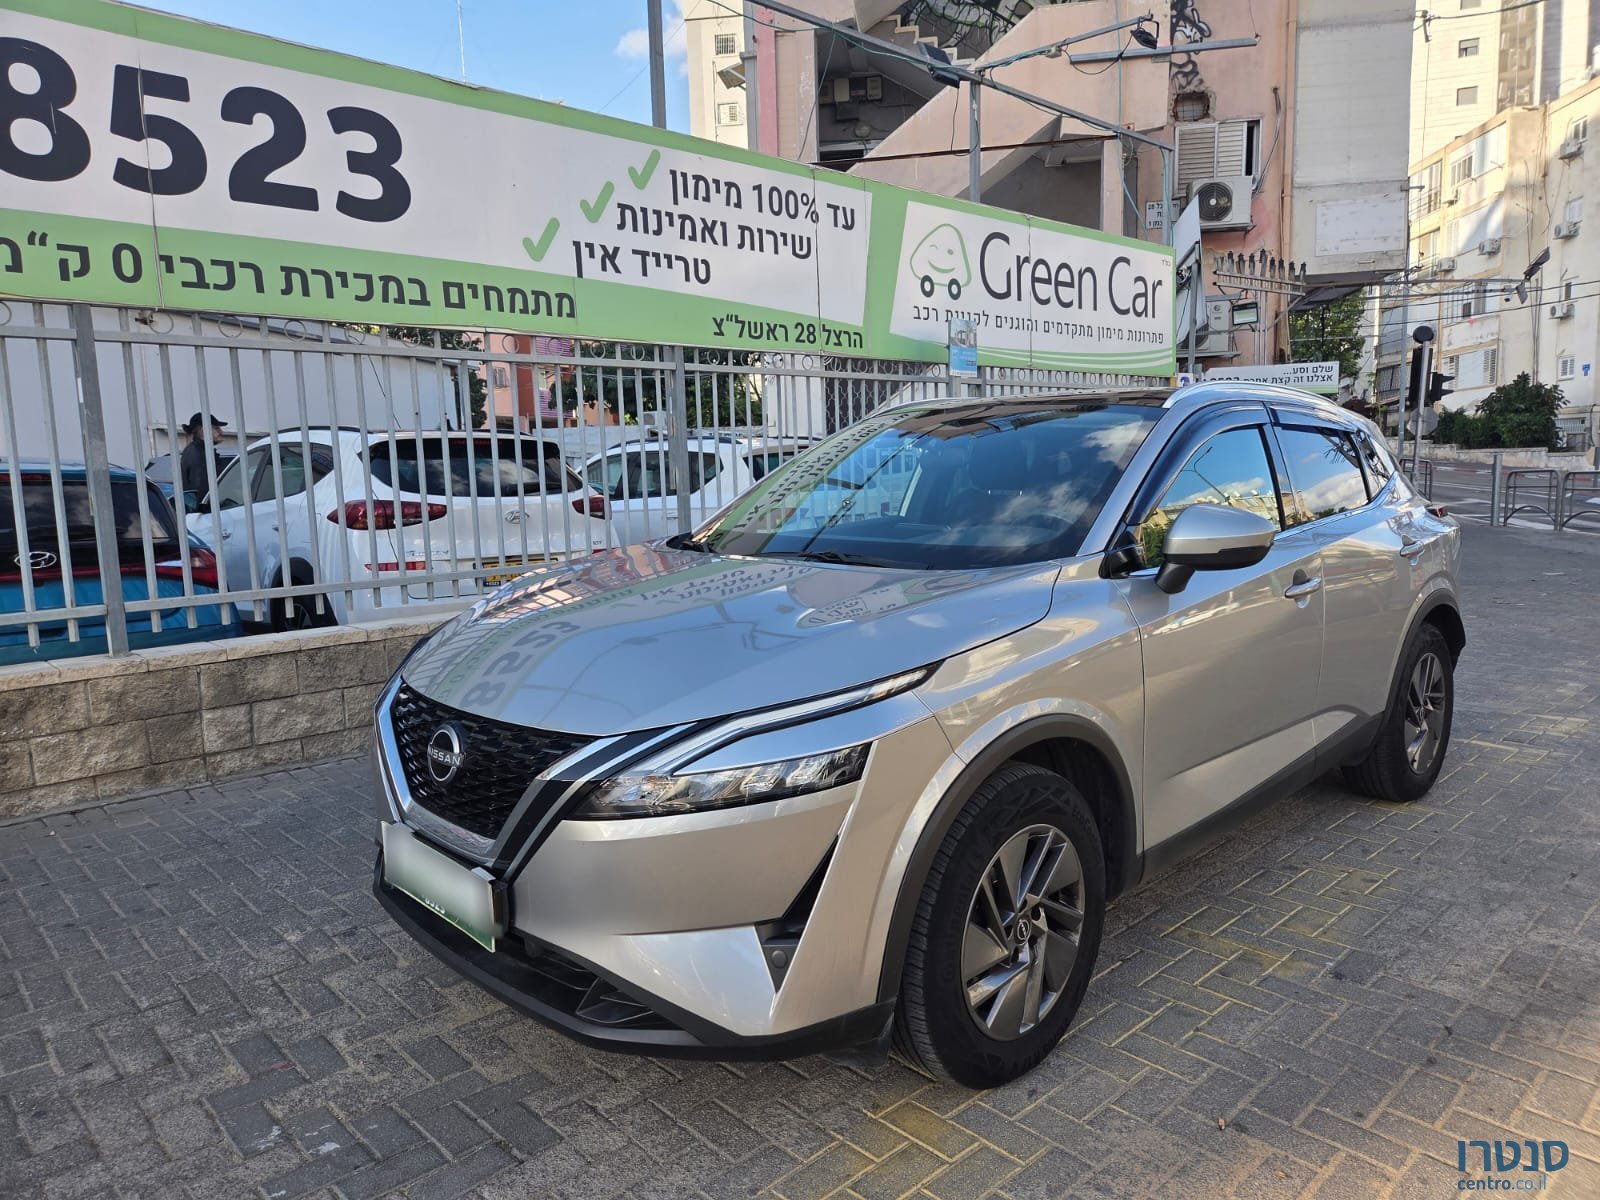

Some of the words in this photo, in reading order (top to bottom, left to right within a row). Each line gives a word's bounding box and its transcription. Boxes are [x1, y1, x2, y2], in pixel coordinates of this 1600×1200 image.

[0, 36, 412, 223] 8523
[669, 169, 742, 210] מימון
[752, 183, 819, 224] 100%
[616, 202, 728, 247] ואמינות
[827, 202, 856, 231] עד
[737, 224, 812, 260] שירות
[112, 242, 143, 283] 0
[159, 254, 266, 294] רכבי
[572, 239, 622, 278] אין
[631, 248, 711, 285] טרייד
[281, 264, 431, 309] במכירת
[979, 231, 1098, 312] Green
[1108, 256, 1163, 319] Car
[443, 279, 577, 319] מתמחים
[913, 304, 938, 321] רכב
[794, 322, 816, 344] 28
[822, 323, 864, 349] הרצל
[995, 315, 1038, 332] והוגנים
[1043, 320, 1093, 339] מתקדמים
[1097, 325, 1123, 342] מימון
[1127, 328, 1164, 344] פתרונות
[1271, 376, 1291, 386] קצת
[1295, 375, 1304, 383] זה
[1306, 373, 1333, 384] אצלנו
[1312, 364, 1334, 374] שלם
